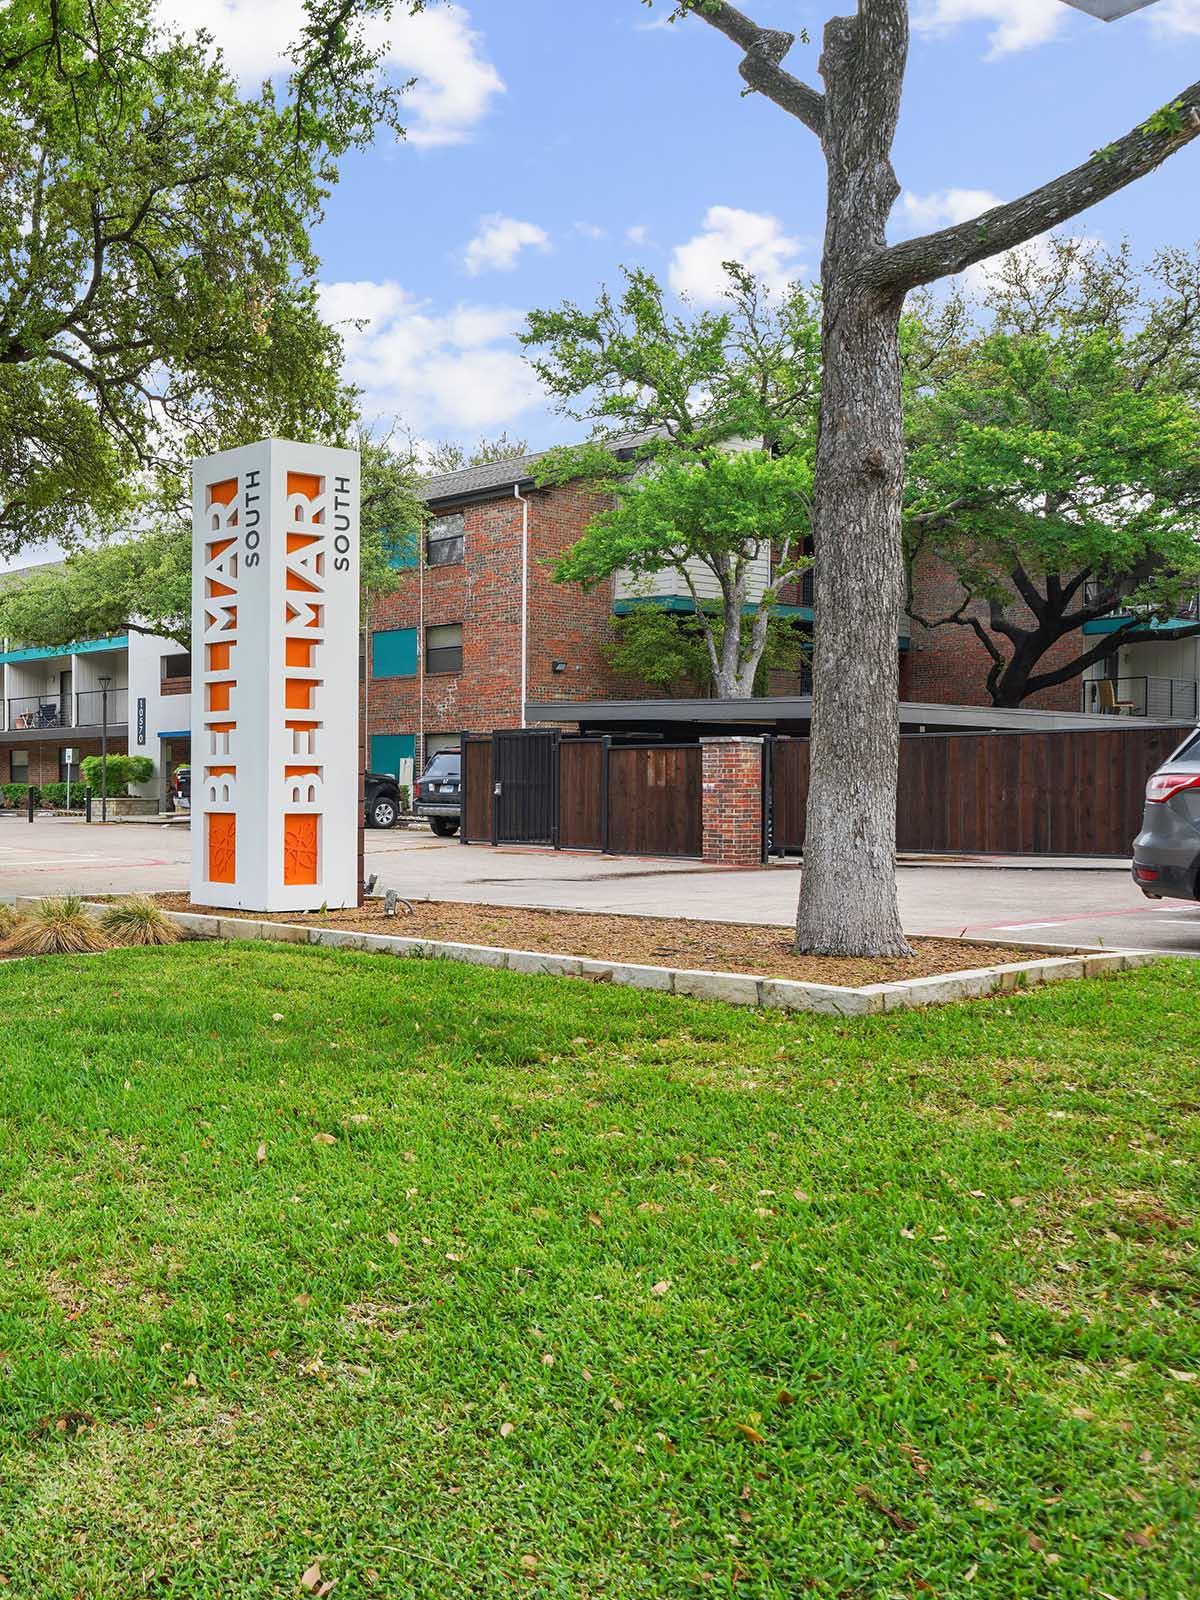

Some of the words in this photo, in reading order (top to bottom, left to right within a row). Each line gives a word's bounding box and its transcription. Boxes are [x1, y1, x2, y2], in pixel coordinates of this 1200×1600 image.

[244, 470, 261, 568] SOUTH
[333, 476, 351, 572] SOUTH
[203, 477, 239, 808] BELLMAR
[284, 471, 326, 808] BELLMAR
